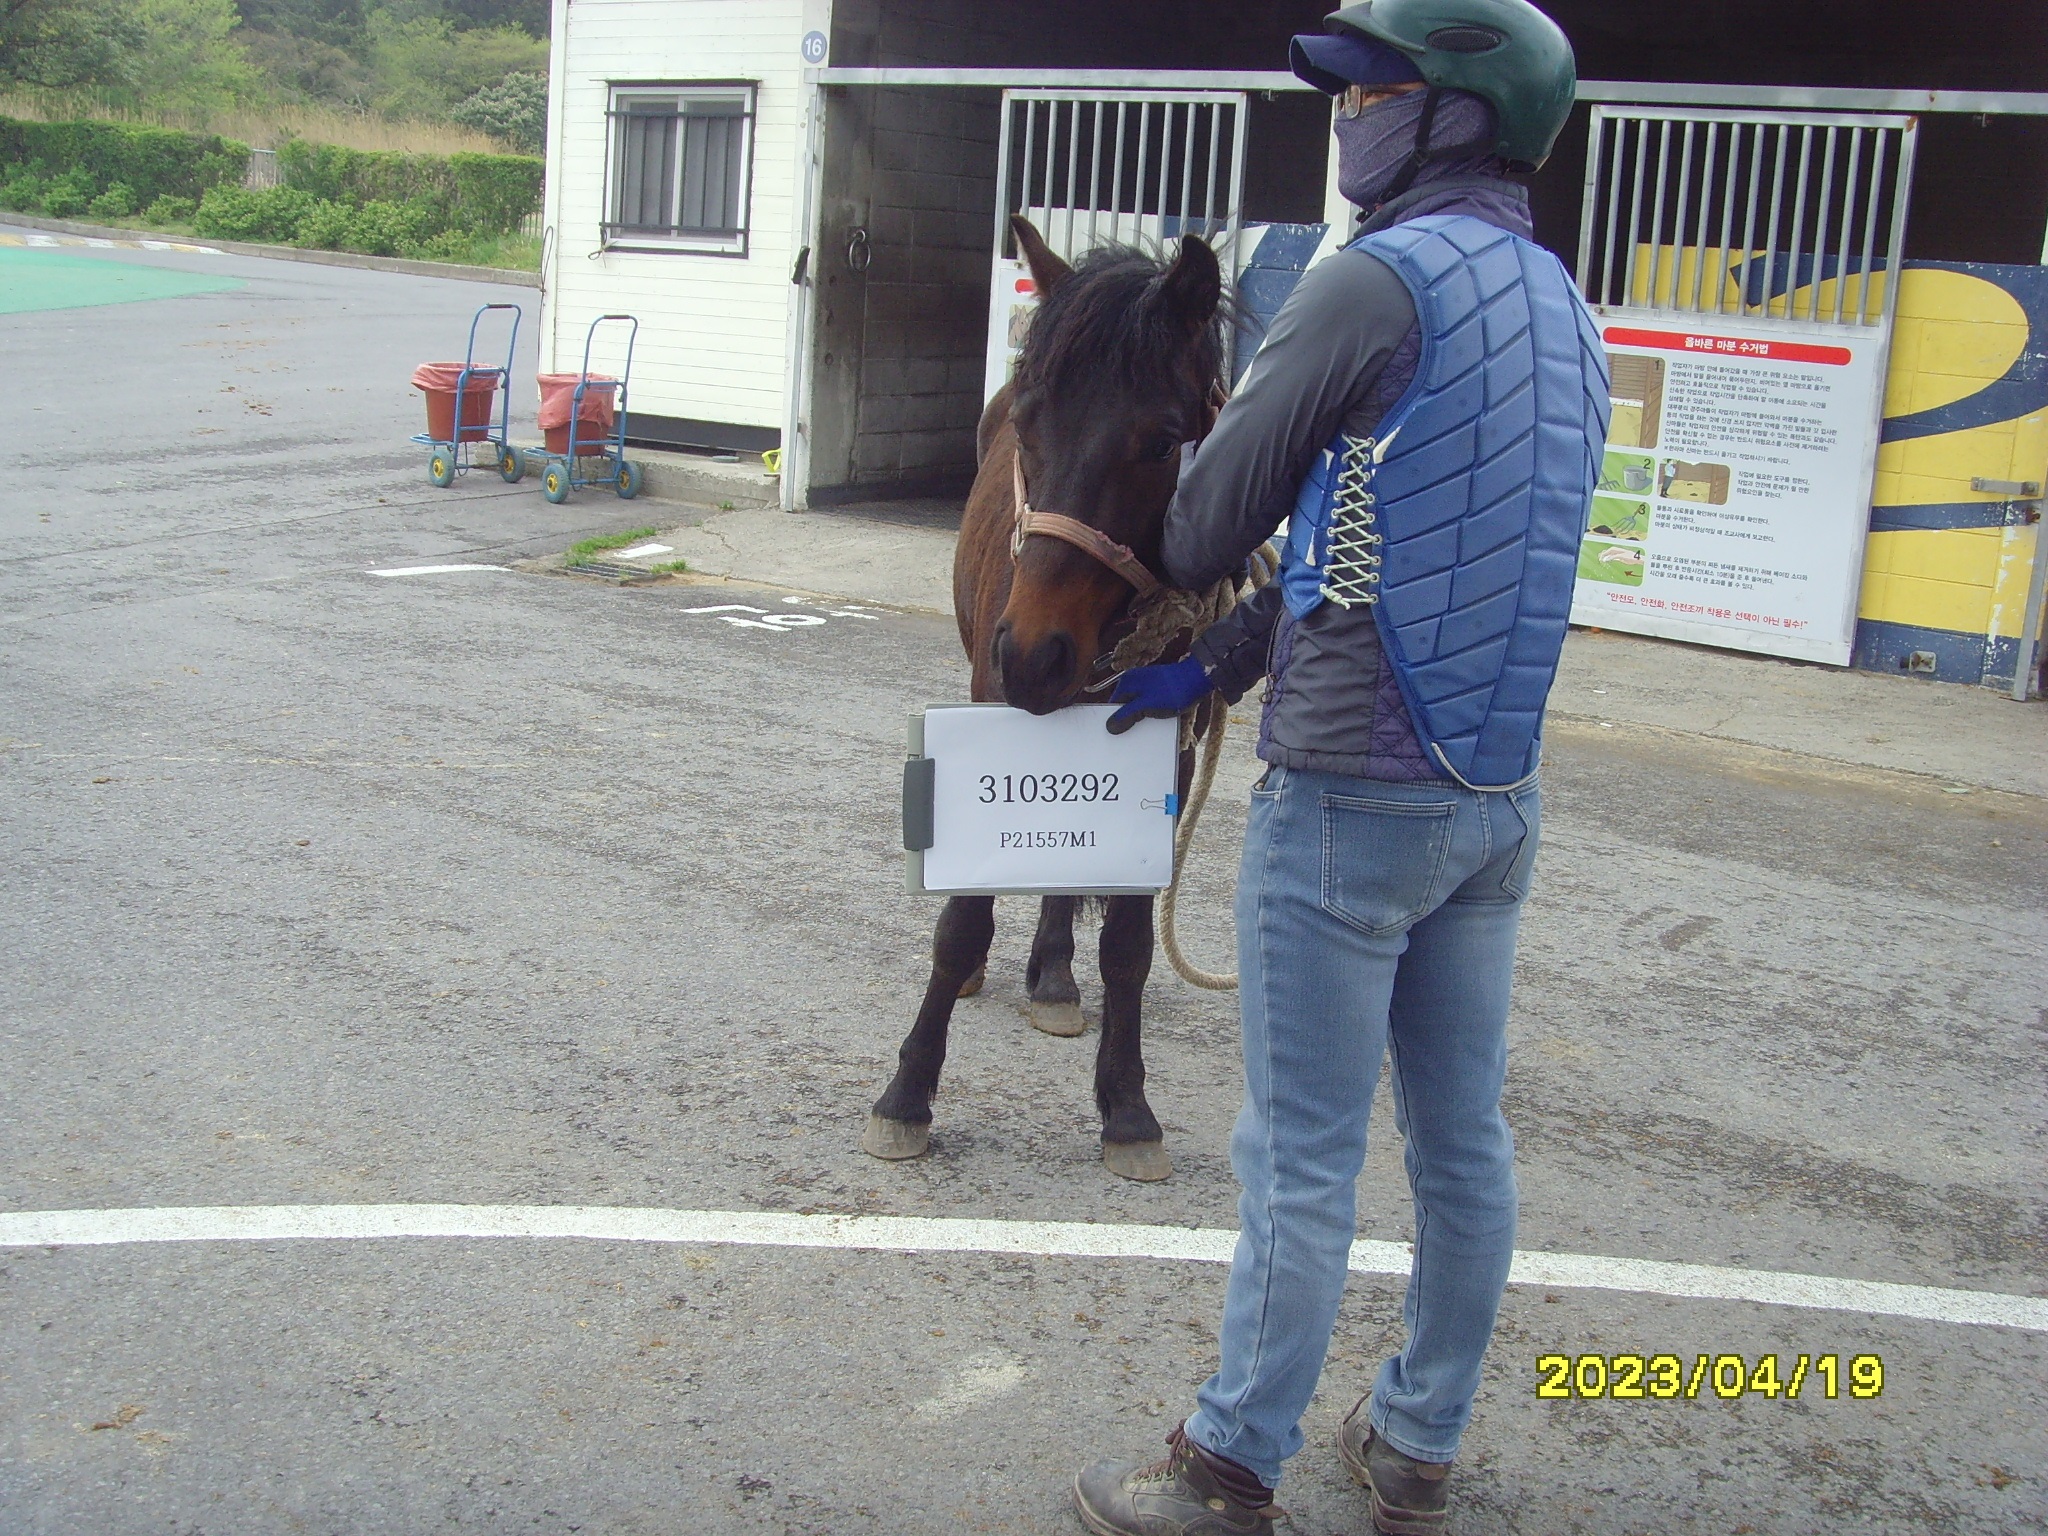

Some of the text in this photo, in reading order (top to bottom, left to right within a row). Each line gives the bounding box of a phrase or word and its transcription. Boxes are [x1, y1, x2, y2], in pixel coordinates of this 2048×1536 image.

[805, 38, 822, 56] 16
[1684, 336, 1768, 355] 올바른 마분 수거법
[1654, 360, 1660, 371] 1
[1643, 459, 1651, 470] 2
[1638, 504, 1646, 515] 3
[1633, 550, 1641, 560] 4
[1671, 601, 1704, 615] 안전조끼
[1707, 606, 1732, 619] 착용은
[1735, 610, 1760, 623] 선택이
[1763, 614, 1780, 626] 아닌
[978, 773, 1119, 803] 3103292
[1000, 831, 1097, 848] P21557M1
